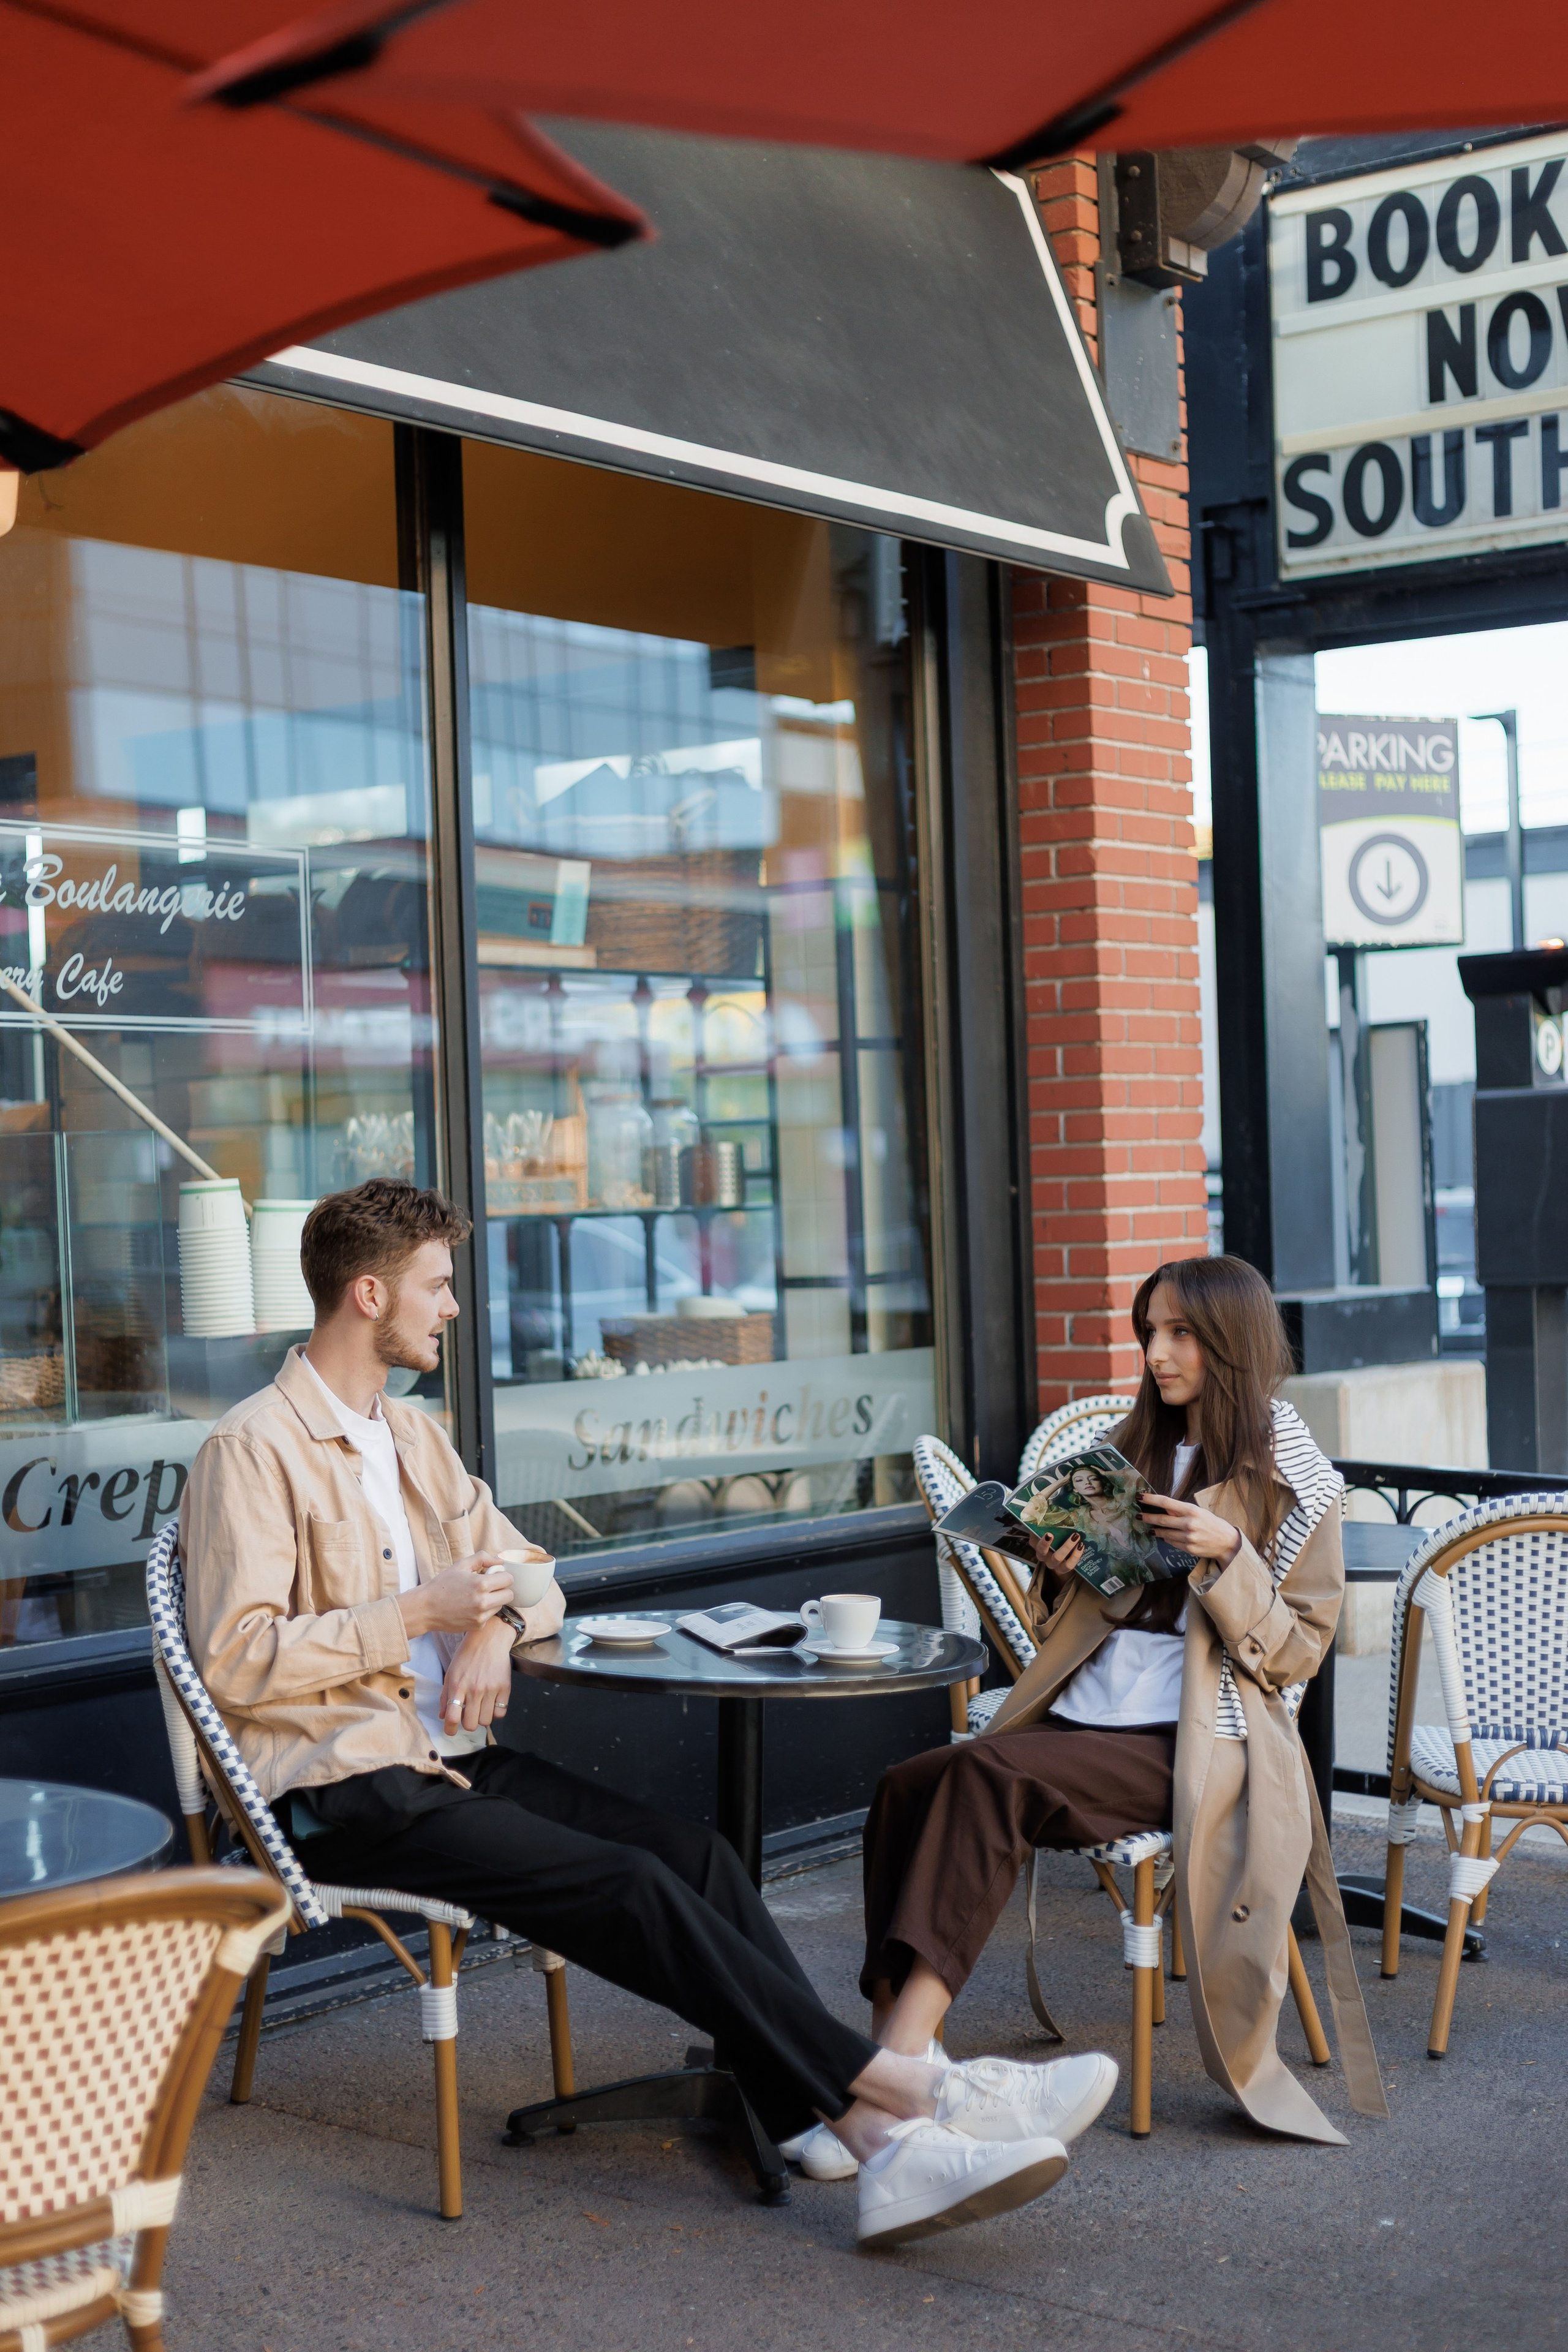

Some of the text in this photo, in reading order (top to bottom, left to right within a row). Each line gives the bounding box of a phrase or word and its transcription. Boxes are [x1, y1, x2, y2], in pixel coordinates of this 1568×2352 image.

[1305, 159, 1568, 303] BOOK
[1427, 285, 1568, 403] NO
[1373, 772, 1406, 792] PAY
[1410, 773, 1450, 793] HERE
[23, 853, 245, 934] Boulangerie
[56, 952, 123, 1007] Cafe
[568, 1384, 873, 1471] Sandwiches
